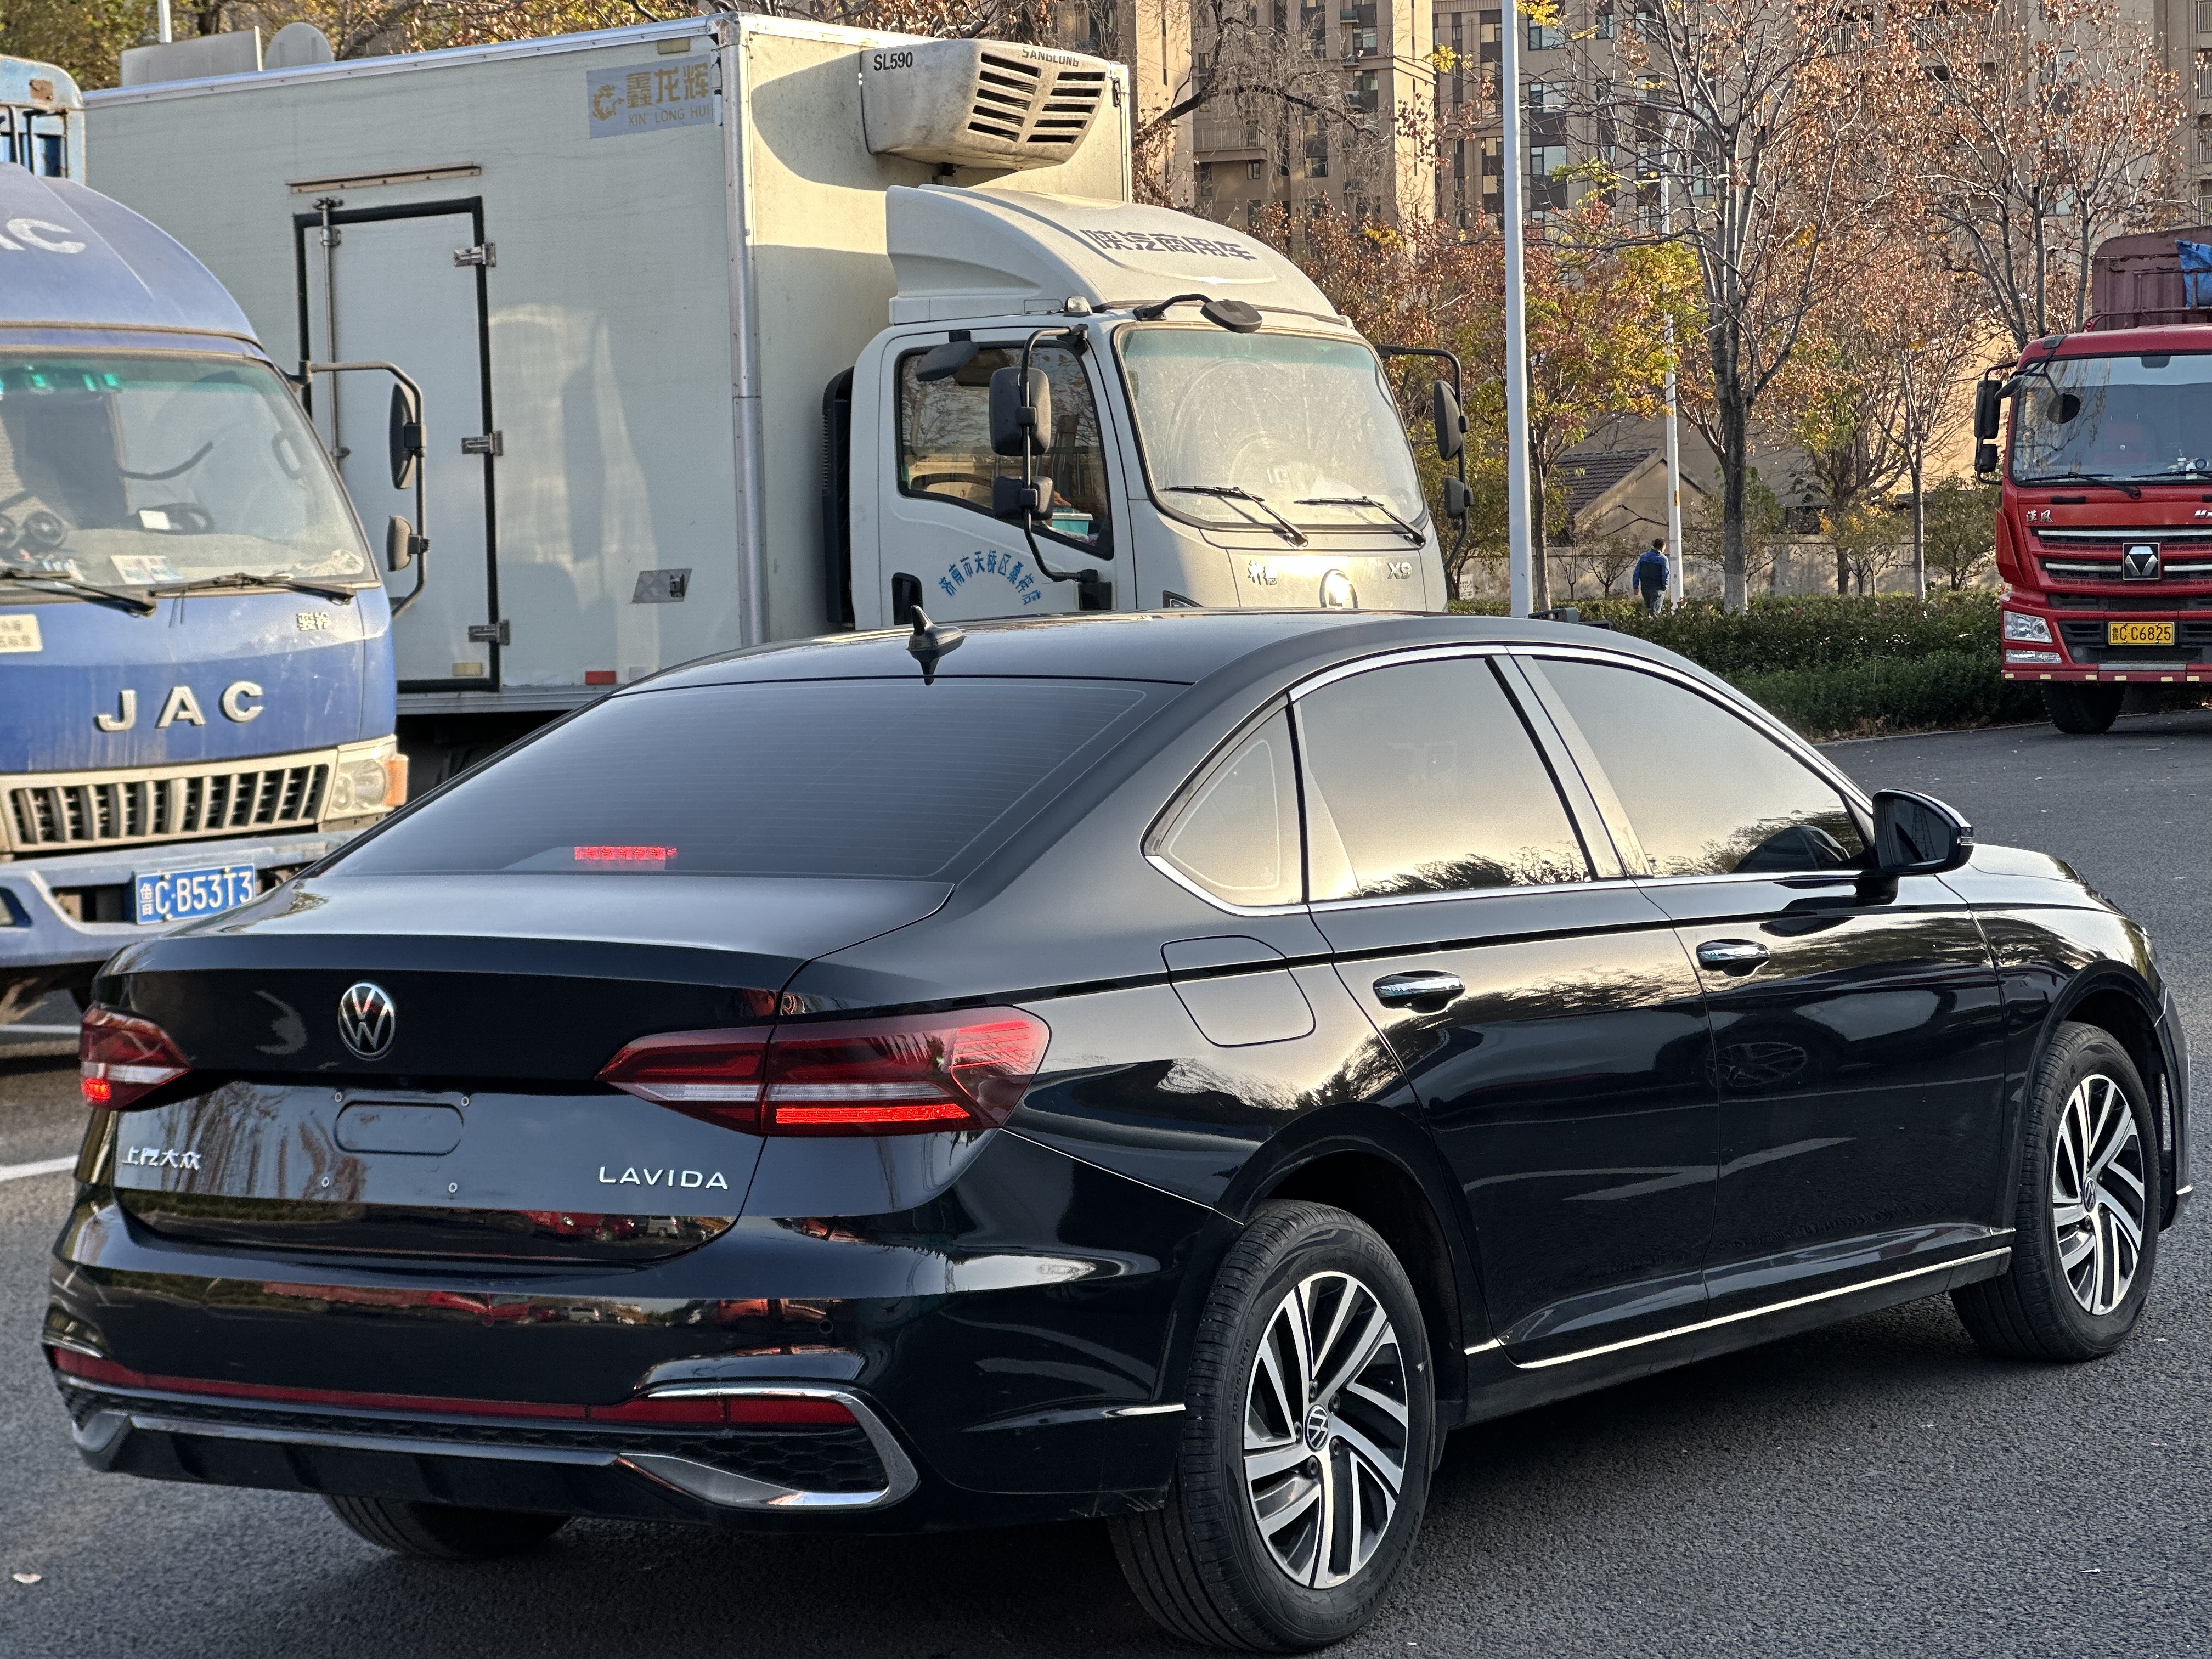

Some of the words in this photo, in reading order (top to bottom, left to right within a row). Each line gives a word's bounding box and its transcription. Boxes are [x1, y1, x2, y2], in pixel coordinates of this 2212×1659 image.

[873, 52, 913, 71] SL590
[1022, 48, 1079, 67] SANGLONG
[626, 63, 709, 109] 鑫龙辉
[628, 114, 646, 127] XIN
[654, 108, 685, 123] LONG
[691, 105, 709, 118] HUI
[1079, 229, 1258, 261] 陕汽商用车
[1387, 562, 1413, 580] X9
[93, 681, 264, 733] JAC
[122, 1146, 201, 1171] 上汽大众
[599, 1166, 729, 1190] LAVIDA
